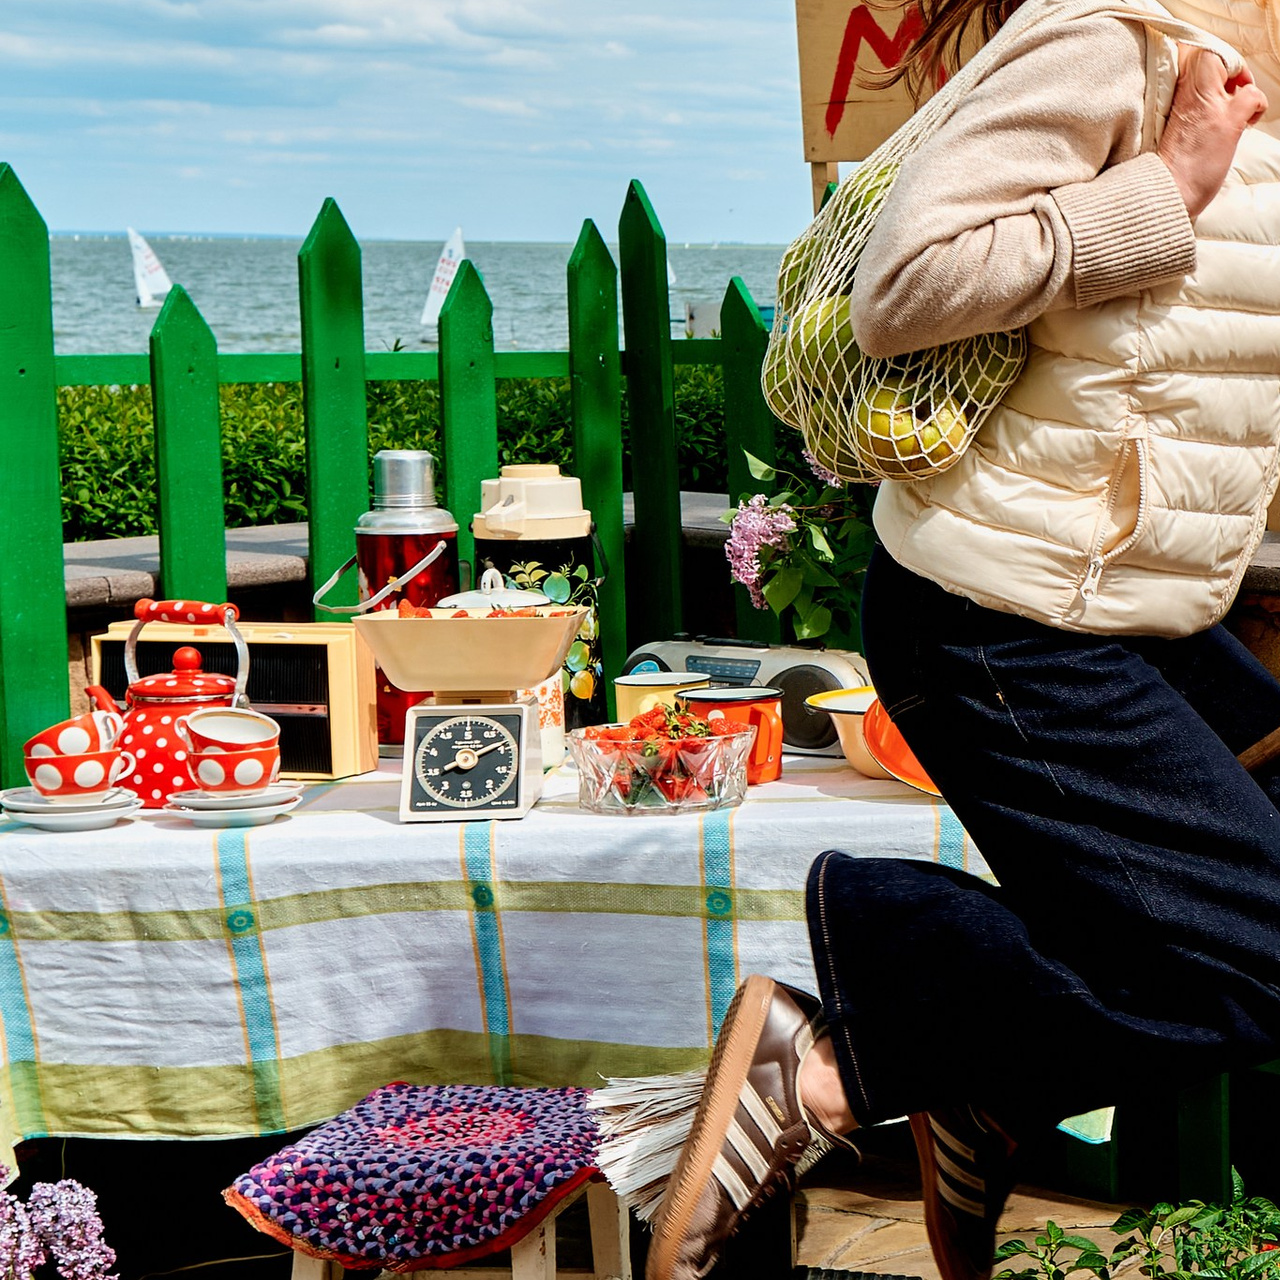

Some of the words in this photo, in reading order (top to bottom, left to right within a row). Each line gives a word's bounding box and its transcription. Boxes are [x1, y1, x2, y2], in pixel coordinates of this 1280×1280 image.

[464, 731, 472, 740] 5
[429, 747, 438, 757] 4
[497, 745, 505, 755] 1
[441, 780, 450, 791] 3
[485, 780, 494, 790] 2
